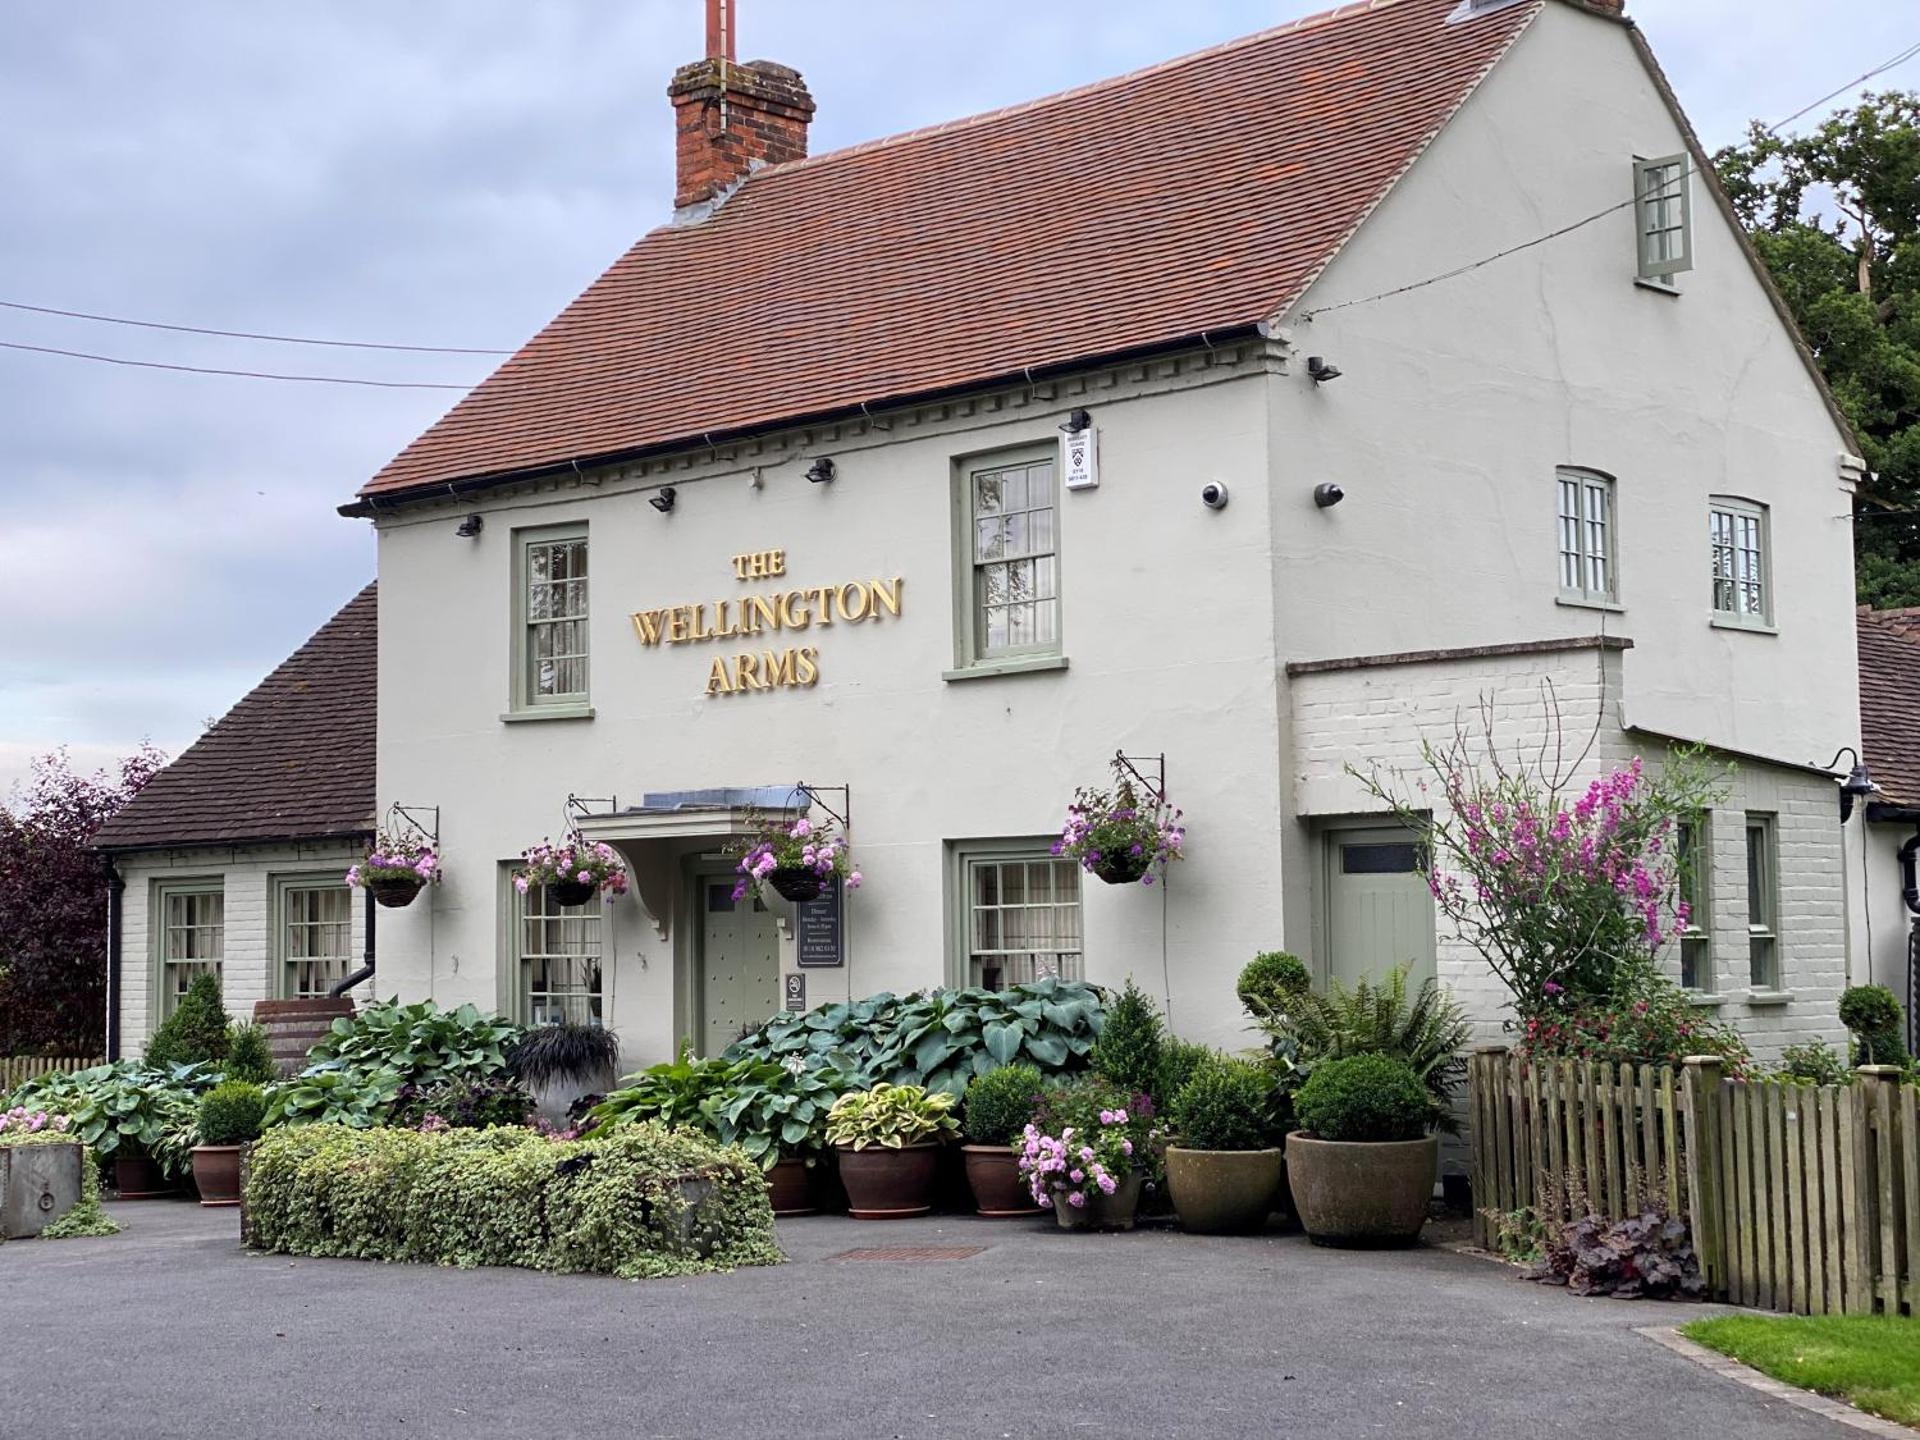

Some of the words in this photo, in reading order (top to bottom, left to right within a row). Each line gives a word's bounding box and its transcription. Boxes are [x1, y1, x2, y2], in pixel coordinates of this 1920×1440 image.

[732, 550, 786, 580] THE
[630, 576, 904, 646] WELLINGTON
[704, 647, 819, 695] ARMS
